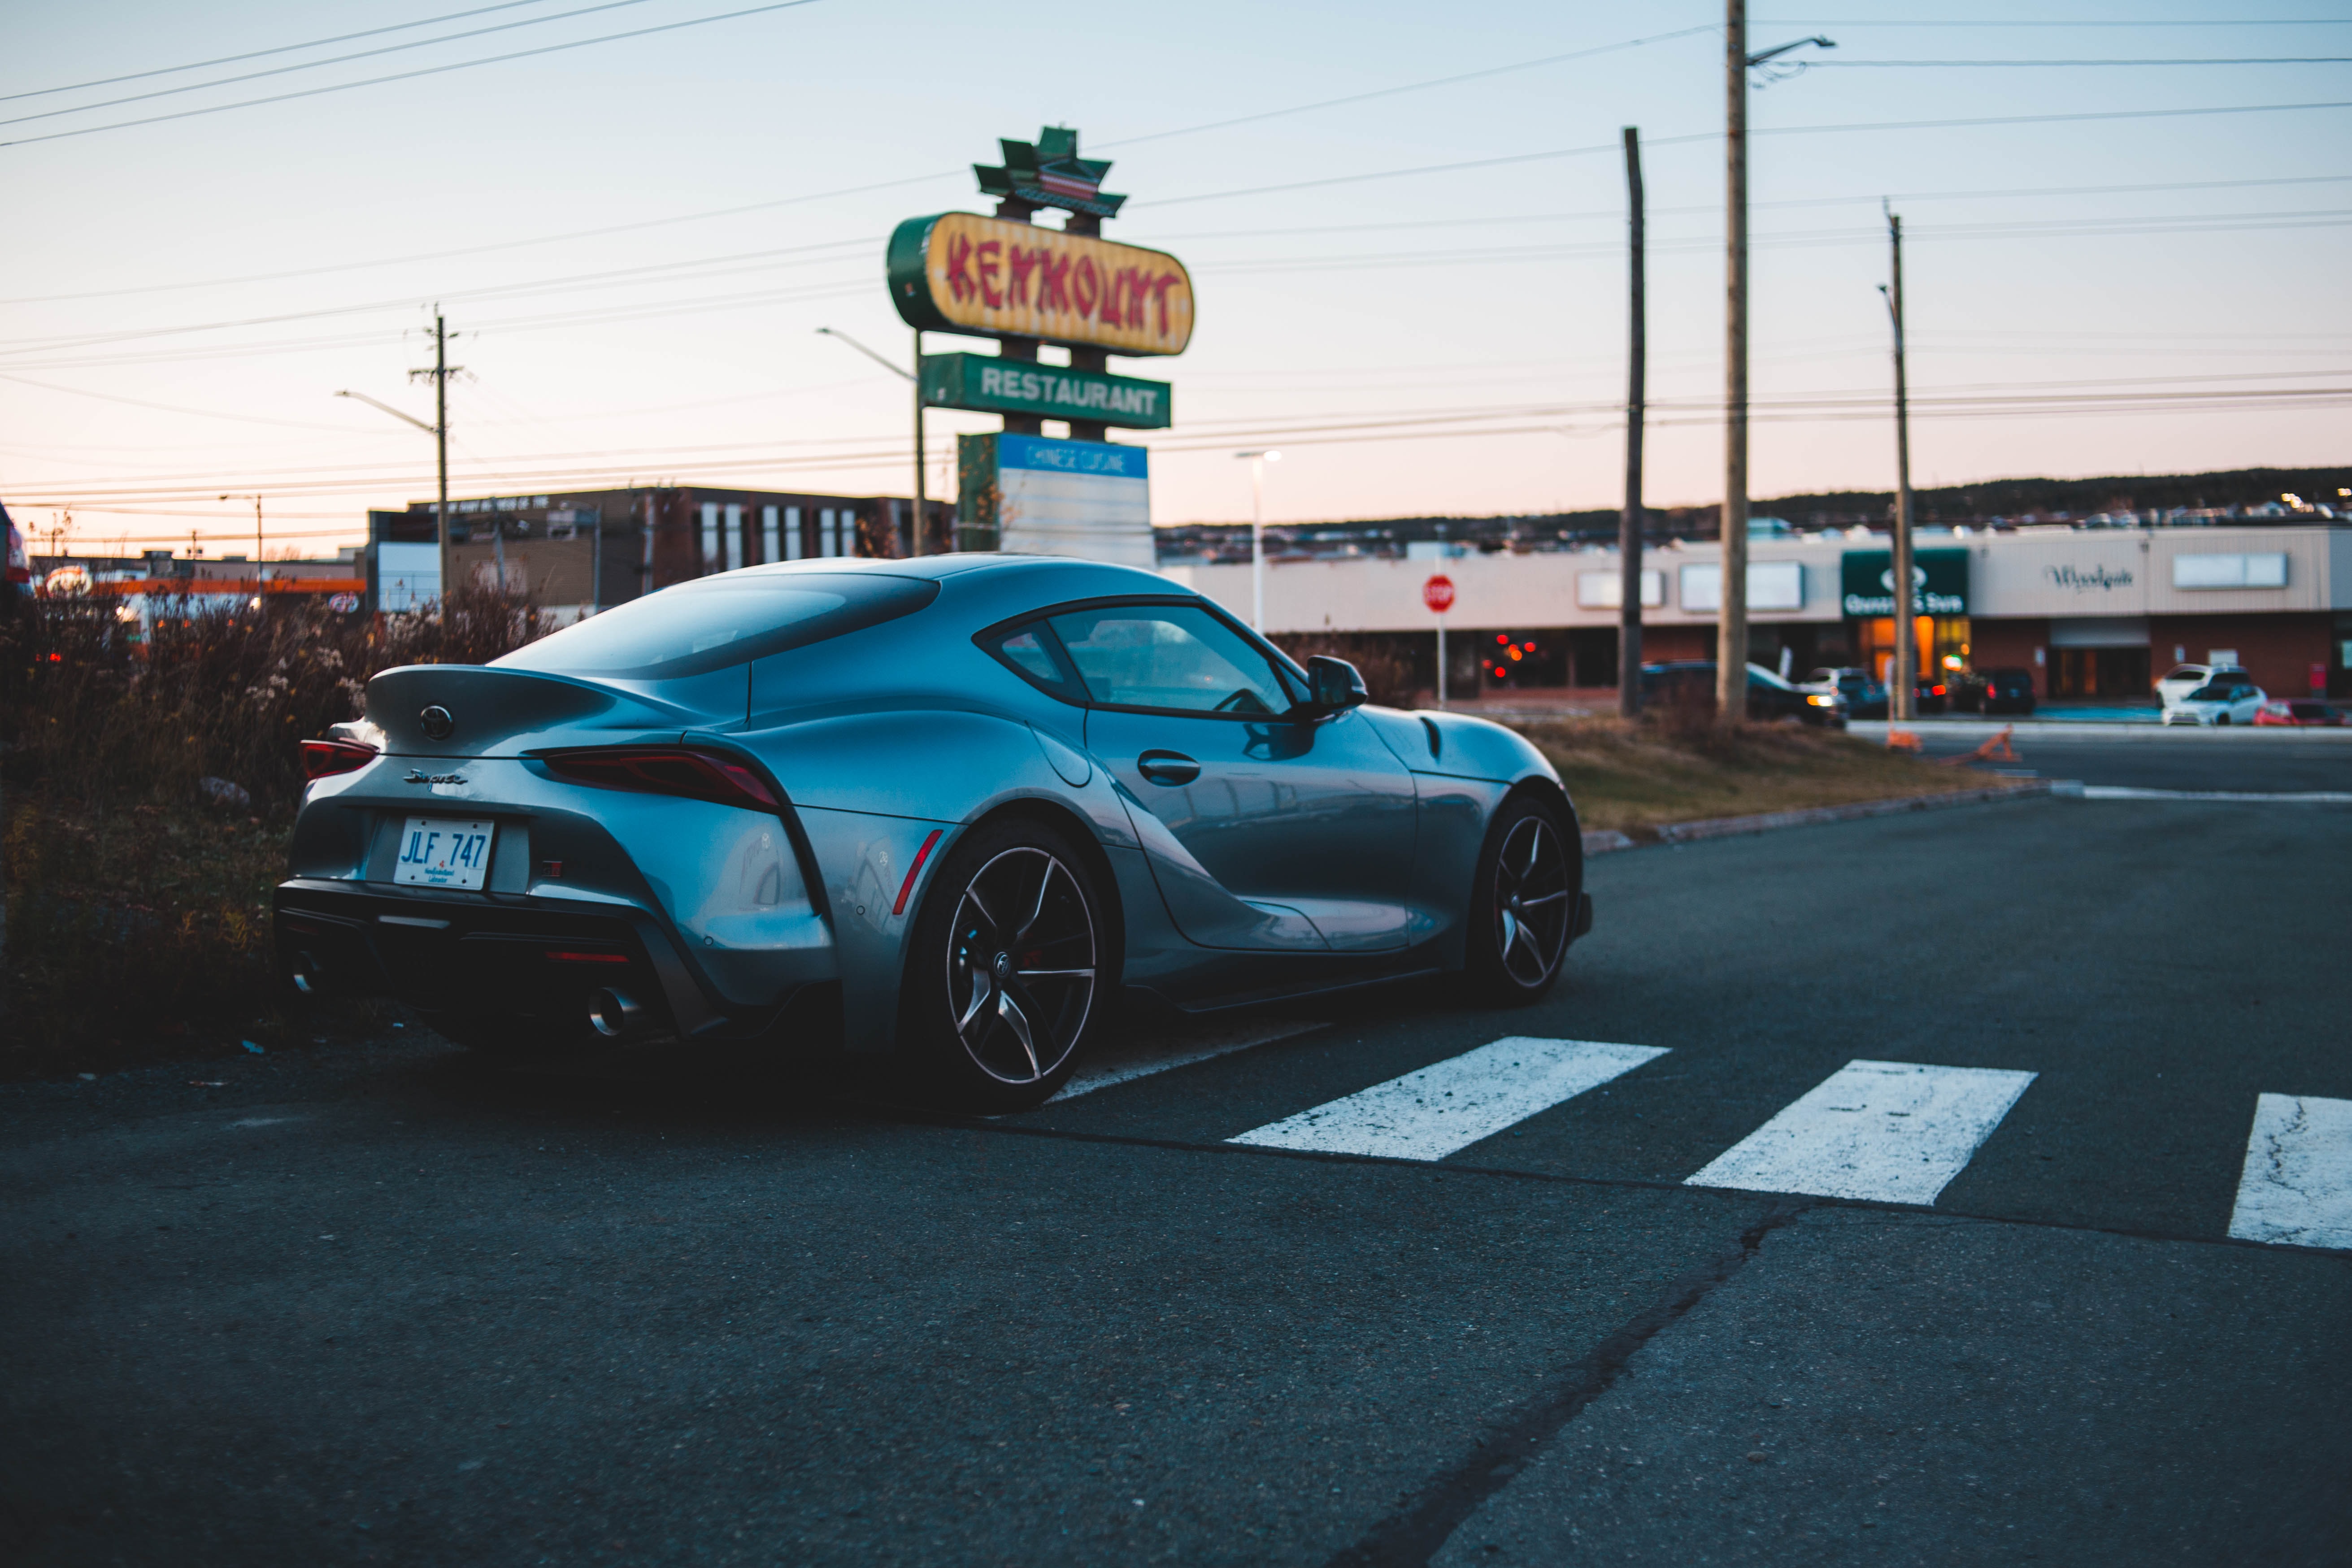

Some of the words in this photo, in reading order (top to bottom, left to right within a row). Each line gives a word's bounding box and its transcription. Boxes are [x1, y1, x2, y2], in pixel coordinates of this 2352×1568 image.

[981, 366, 1158, 416] RESTAURANT
[1423, 586, 1453, 602] STOP
[403, 768, 468, 792] Supra
[401, 831, 440, 864] JLF
[450, 834, 486, 867] 747
